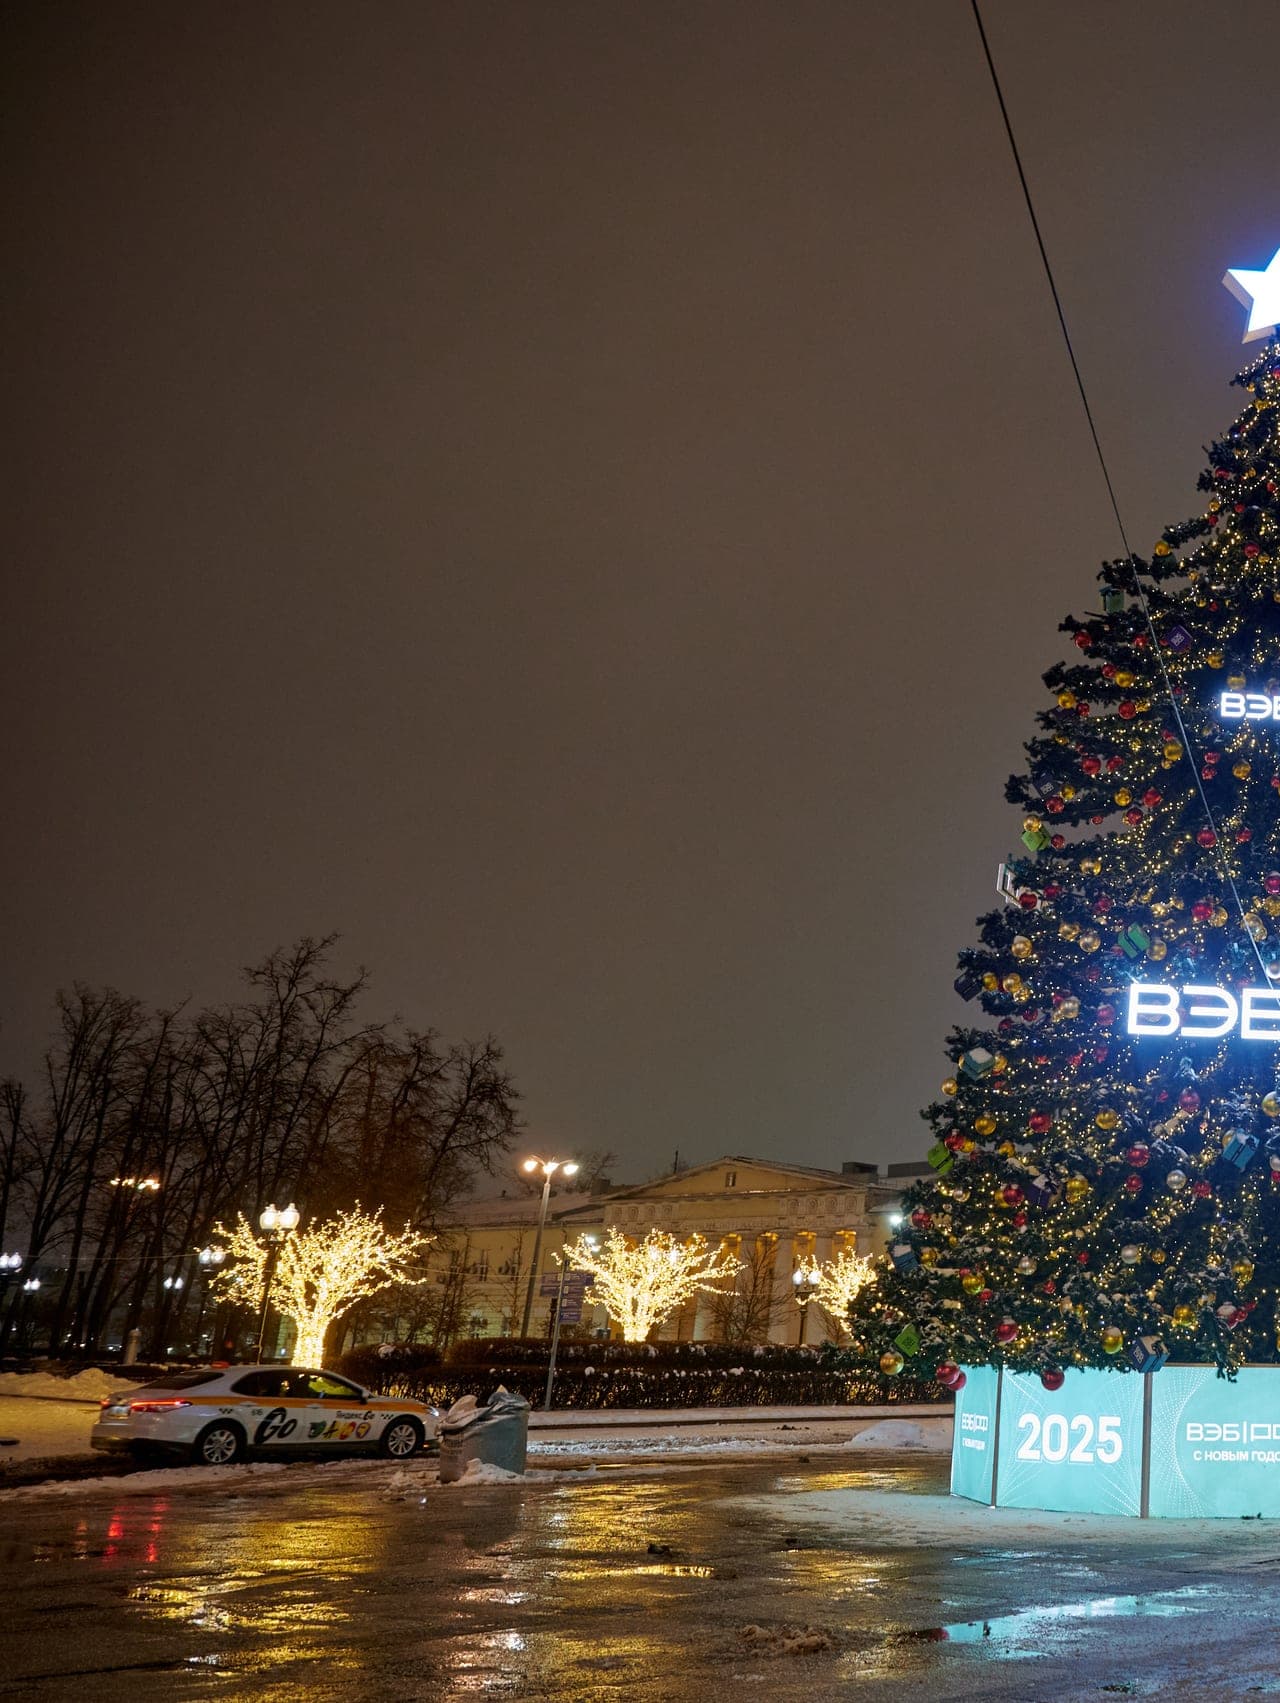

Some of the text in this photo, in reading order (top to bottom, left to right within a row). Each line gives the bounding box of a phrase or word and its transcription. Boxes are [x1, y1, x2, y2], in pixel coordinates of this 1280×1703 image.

[254, 1407, 298, 1443] Go
[1017, 1413, 1123, 1464] 2025
[1193, 1450, 1202, 1461] С
[1204, 1450, 1249, 1462] НОВЫМ
